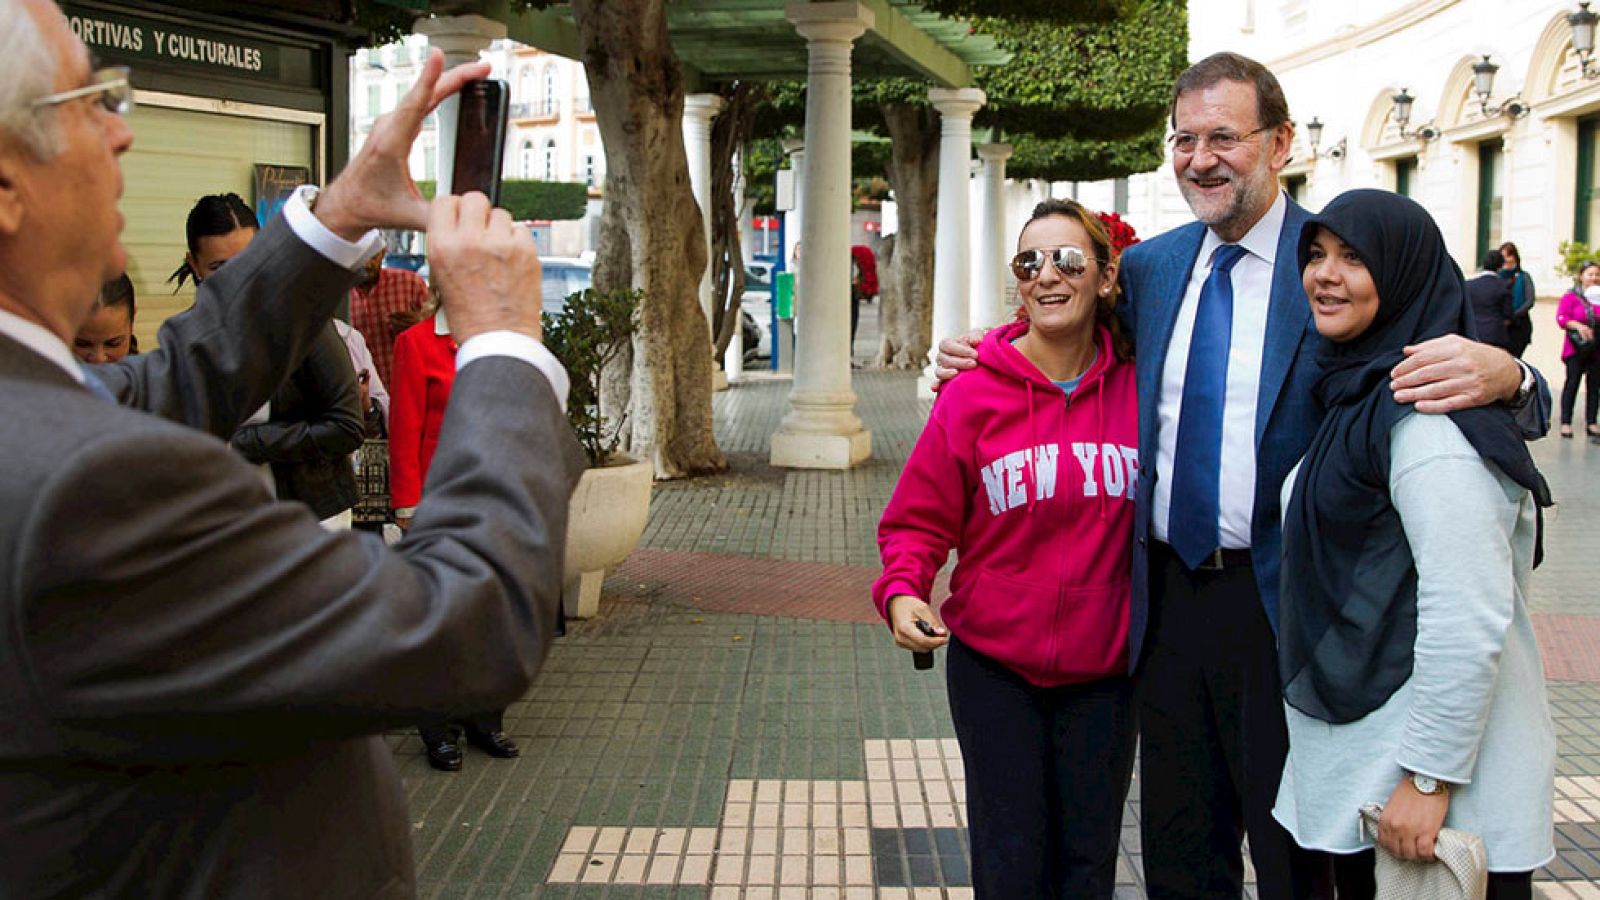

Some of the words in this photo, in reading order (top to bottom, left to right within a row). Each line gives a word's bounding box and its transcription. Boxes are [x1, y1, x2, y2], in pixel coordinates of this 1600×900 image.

[65, 14, 143, 51] ORTIVAS
[154, 30, 165, 54] Y
[168, 34, 262, 71] CULTURALES
[980, 443, 1059, 516] NEW
